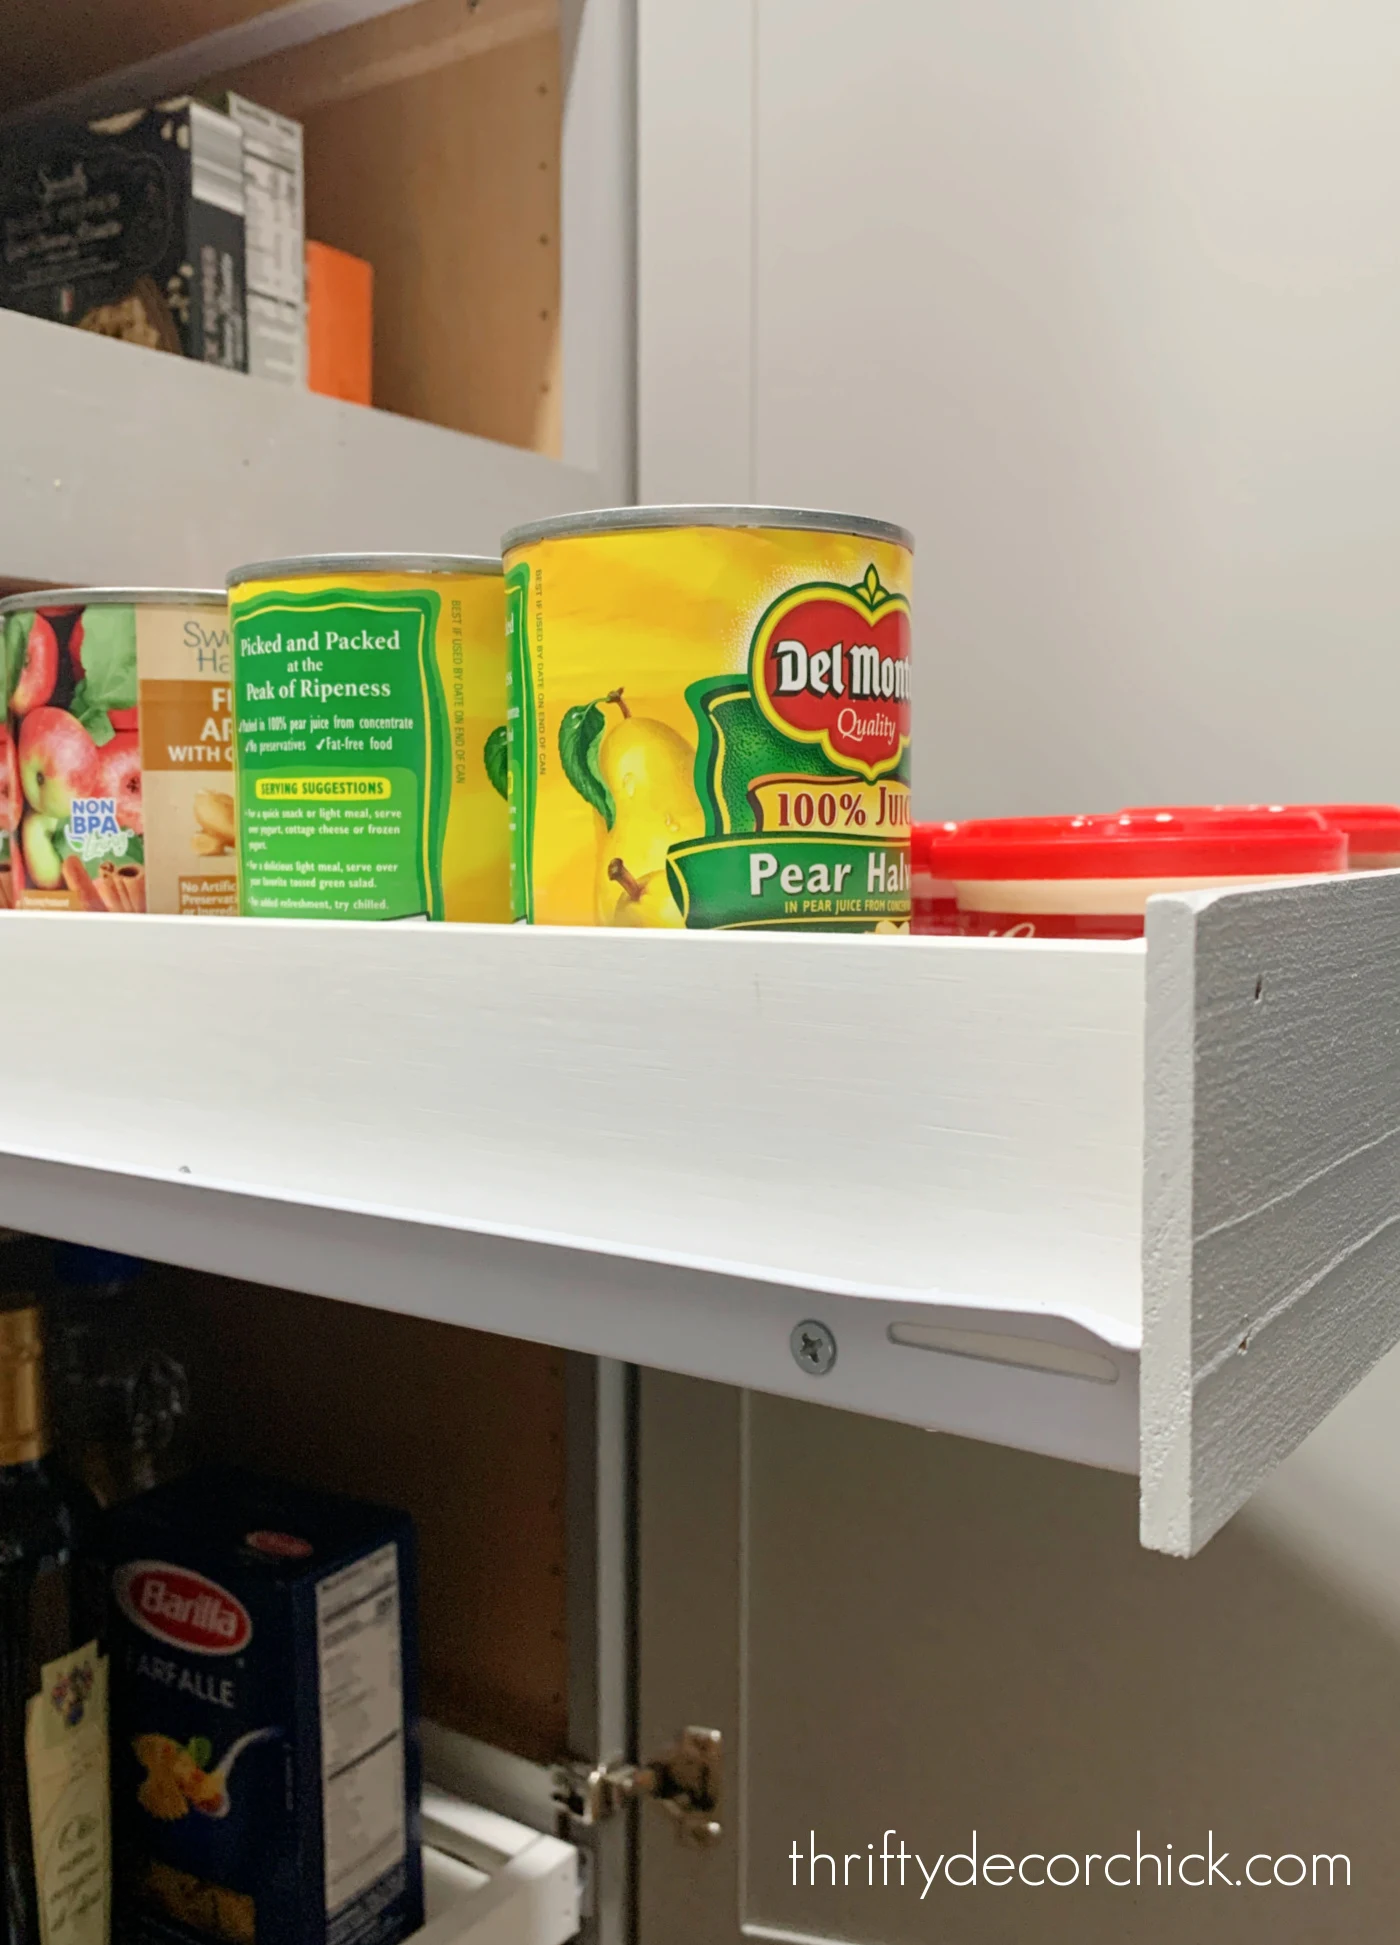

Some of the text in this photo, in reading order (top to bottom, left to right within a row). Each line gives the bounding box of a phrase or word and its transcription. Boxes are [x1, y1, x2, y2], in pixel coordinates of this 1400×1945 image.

[535, 600, 543, 609] IF
[241, 630, 400, 657] Picked and Packed
[536, 645, 544, 659] BY
[287, 657, 323, 673] at the
[774, 639, 846, 697] Del
[246, 679, 391, 702] Peak of Ripeness
[451, 600, 466, 784] BEST IF USED BY DATE ON END OF CAN
[538, 693, 545, 709] ON
[268, 716, 287, 731] 100%
[290, 719, 306, 734] pear
[310, 715, 329, 733] juice
[334, 715, 355, 729] from
[359, 717, 413, 729] concentrate
[538, 712, 546, 734] END
[837, 707, 896, 746] Quality
[259, 738, 306, 755] preservatives
[326, 736, 364, 750] Fat-free
[370, 736, 392, 750] food
[539, 739, 546, 750] OF
[168, 745, 220, 762] WITH
[539, 753, 547, 775] CAN
[261, 782, 384, 795] SERVING SUGGESTIONS
[72, 800, 114, 814] NON
[262, 809, 279, 820] quick
[282, 809, 303, 818] snack
[306, 810, 316, 819] or
[319, 808, 341, 821] light
[344, 808, 372, 819] meal,
[375, 810, 402, 819] serve
[777, 792, 866, 827] 100%
[73, 815, 118, 834] BPA
[285, 825, 315, 837] cottage
[318, 825, 349, 834] cheese
[353, 826, 364, 834] or
[368, 825, 400, 834] frozen
[264, 861, 293, 871] delicious
[296, 861, 315, 874] light
[318, 861, 343, 873] meal,
[346, 864, 372, 872] serve
[376, 864, 398, 872] over
[750, 852, 852, 896] Pear
[181, 880, 199, 893] No
[290, 878, 316, 888] tossed
[319, 880, 345, 890] green
[349, 878, 377, 888] salad.
[335, 901, 349, 912] try
[353, 899, 389, 910] chilled.
[784, 901, 798, 913] IN
[803, 900, 832, 912] PEAR
[835, 900, 861, 915] JUICE
[864, 900, 885, 912] FROM
[140, 1578, 238, 1638] Barilla
[124, 1646, 236, 1708] FARFALLE
